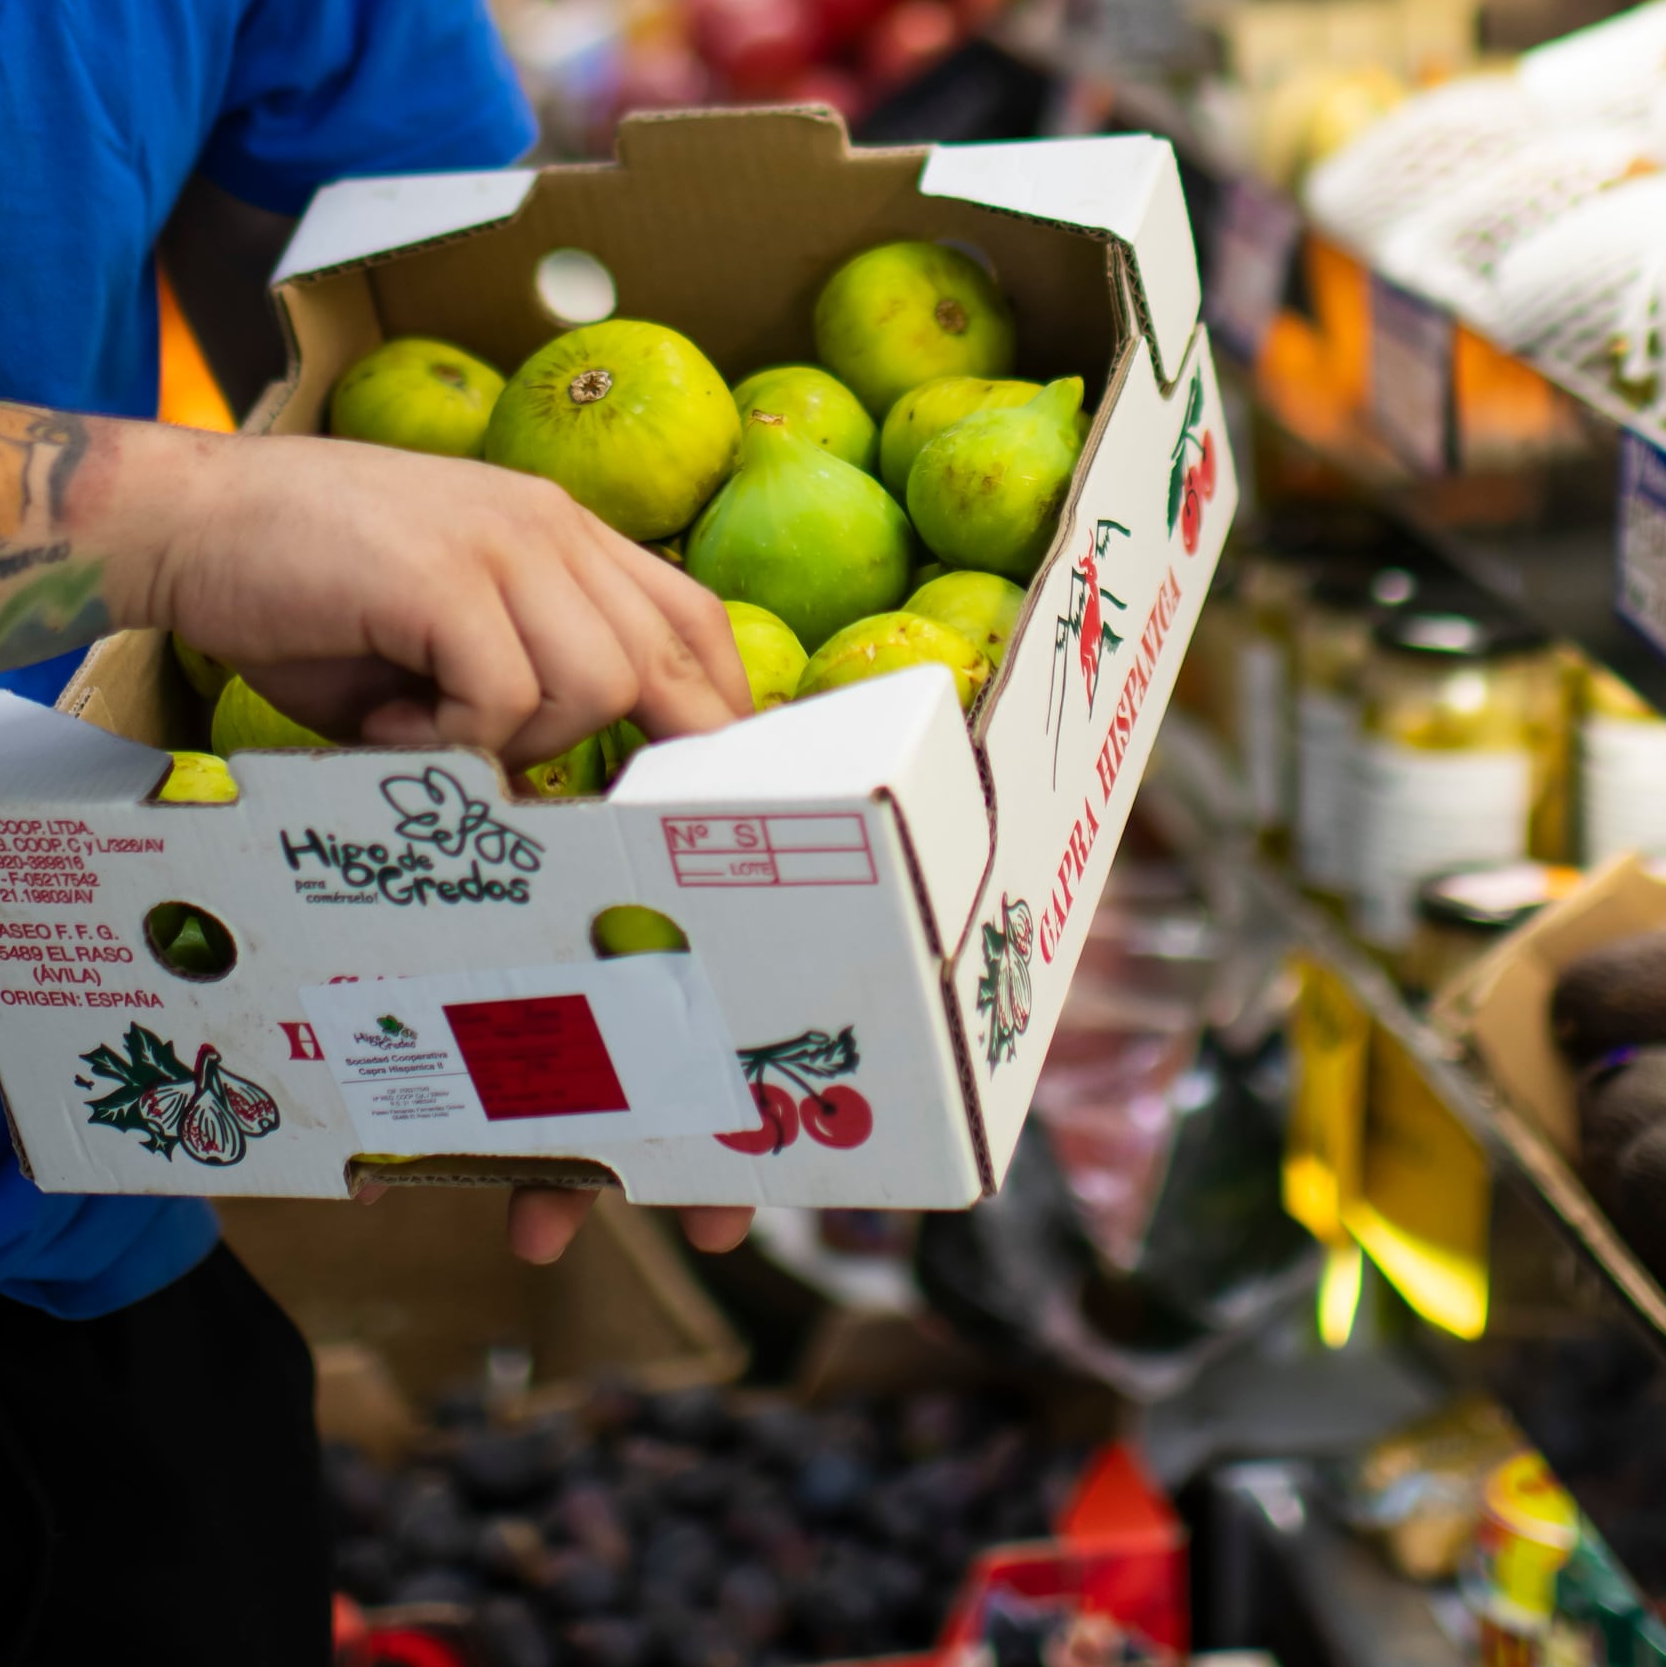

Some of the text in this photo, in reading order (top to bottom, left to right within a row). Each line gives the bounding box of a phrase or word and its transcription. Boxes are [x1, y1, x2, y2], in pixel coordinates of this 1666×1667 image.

[1039, 565, 1183, 965] CAPRA HISPANICA
[47, 820, 94, 835] LTDA.
[13, 837, 65, 853] COOP.
[67, 838, 81, 852] C
[84, 842, 93, 856] y
[280, 828, 434, 887] Higo de
[730, 862, 773, 877] LOTE
[294, 880, 326, 892] para
[377, 859, 531, 906] Gredos
[306, 891, 380, 904] comérselo!
[55, 923, 73, 940] F.
[75, 924, 94, 940] F.
[96, 924, 119, 941] G.
[46, 946, 74, 962] EL
[75, 946, 133, 963] RASO
[33, 964, 101, 987] (ÁVILA)
[0, 989, 165, 1008] ORIGEN: ESPAÑA
[345, 1051, 449, 1066] Sociedad Cooperativa
[359, 1066, 387, 1077] Capra
